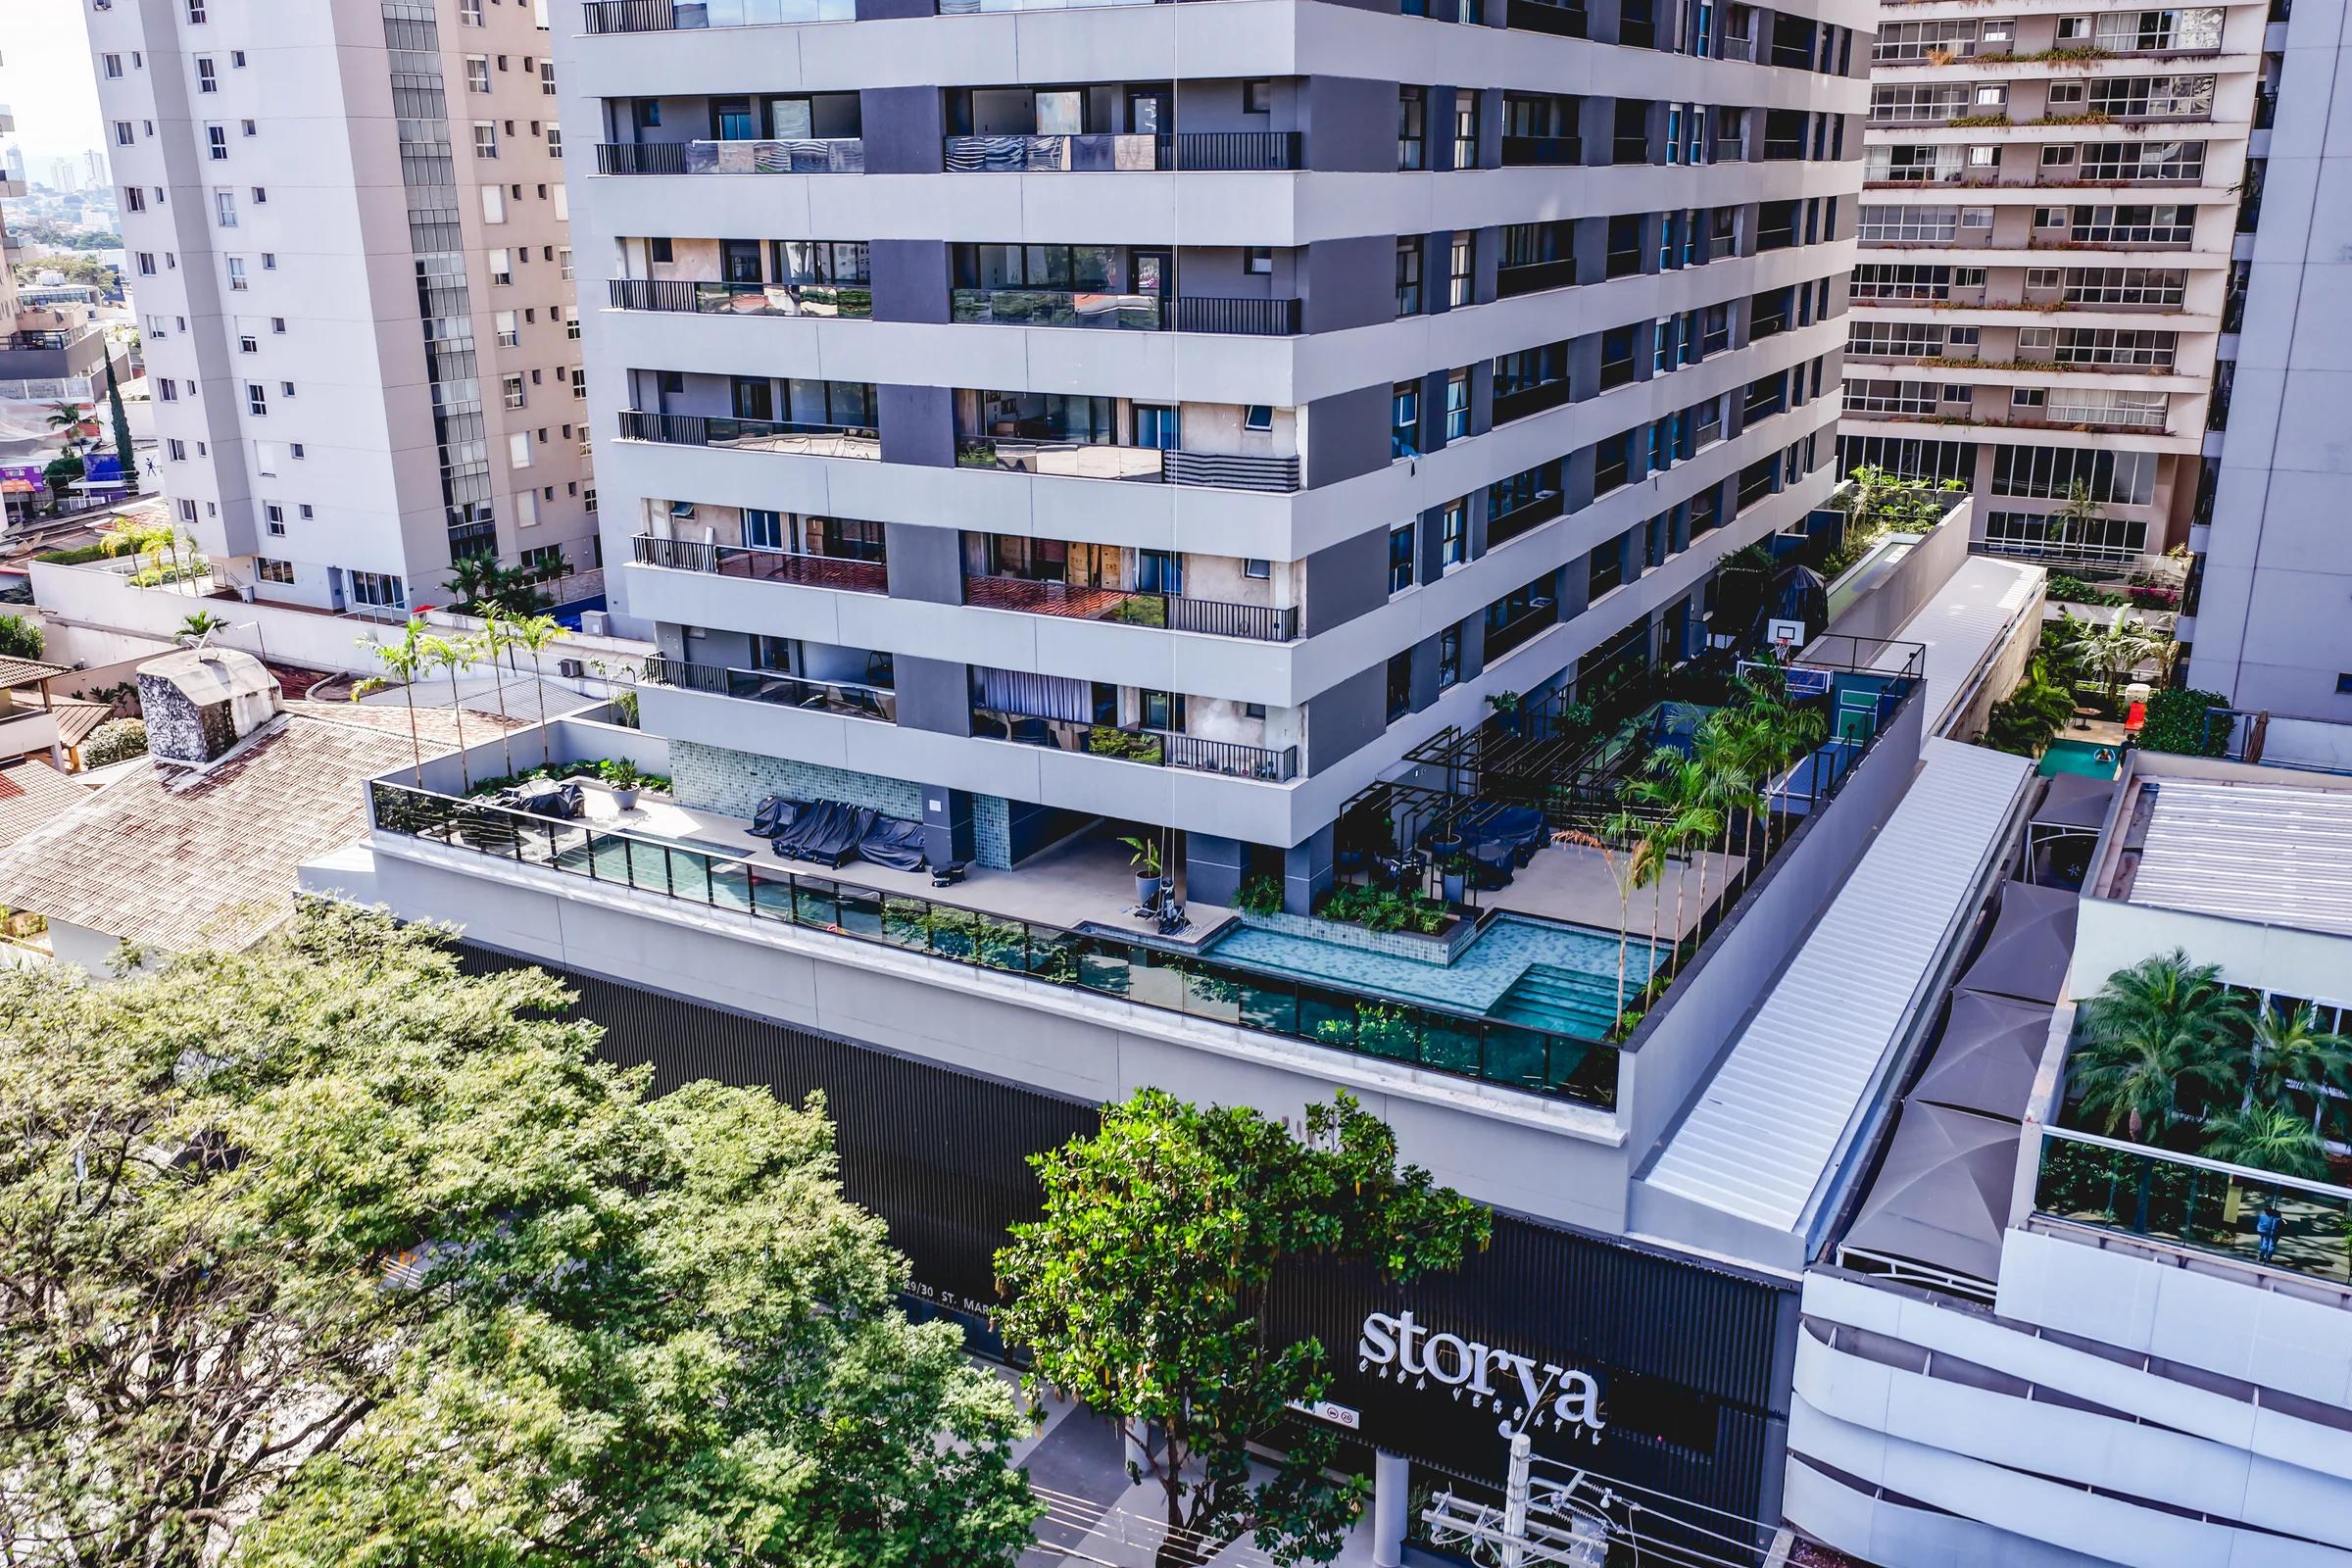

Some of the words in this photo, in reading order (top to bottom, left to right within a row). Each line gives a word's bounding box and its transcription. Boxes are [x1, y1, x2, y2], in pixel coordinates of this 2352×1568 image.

[942, 1291, 957, 1304] ST.
[963, 1298, 990, 1316] MAR
[1358, 1356, 1426, 1391] CASA
[1359, 1309, 1605, 1440] storya
